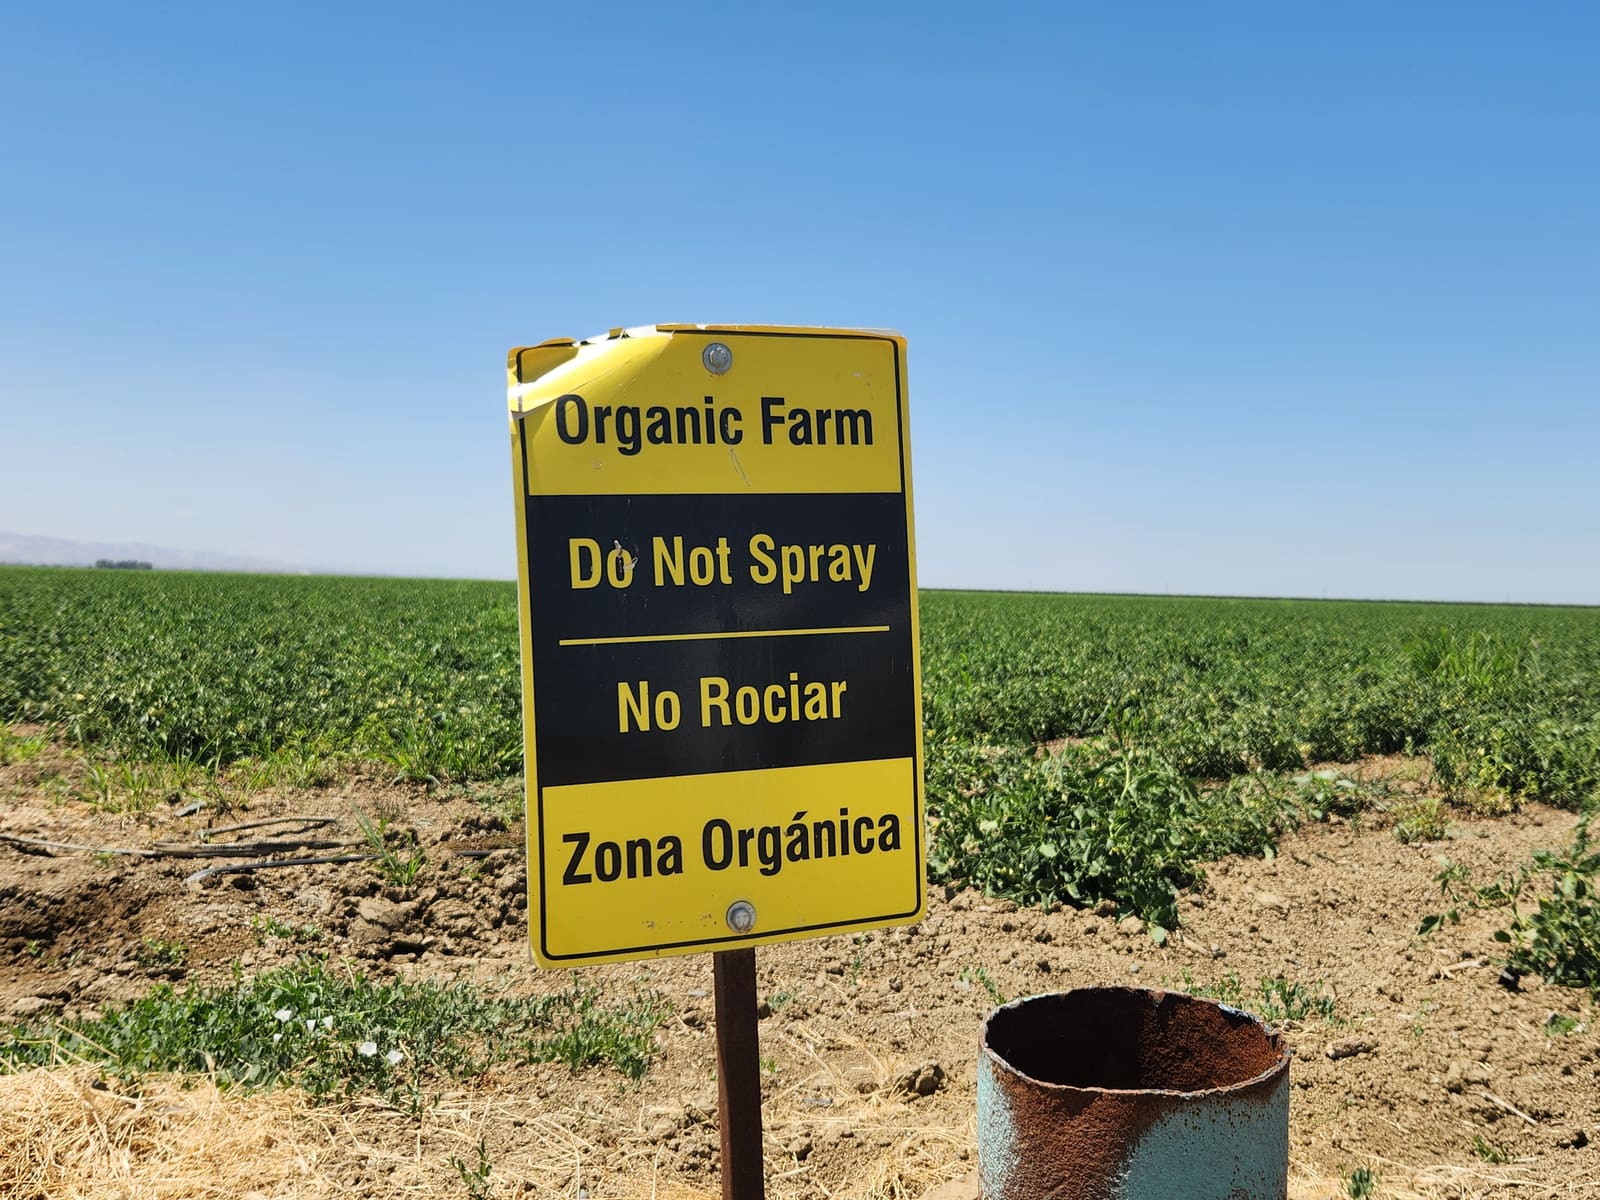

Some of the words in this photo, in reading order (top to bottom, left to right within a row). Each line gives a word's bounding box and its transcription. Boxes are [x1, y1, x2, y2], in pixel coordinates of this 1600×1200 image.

[555, 393, 744, 456] Organic
[760, 396, 874, 446] Farm
[568, 536, 634, 590] Do
[652, 535, 733, 588] Not
[748, 533, 877, 595] Spray
[617, 680, 681, 734] No
[700, 672, 848, 728] Rociar
[561, 831, 684, 886] Zona
[701, 807, 902, 876] Orgánica
